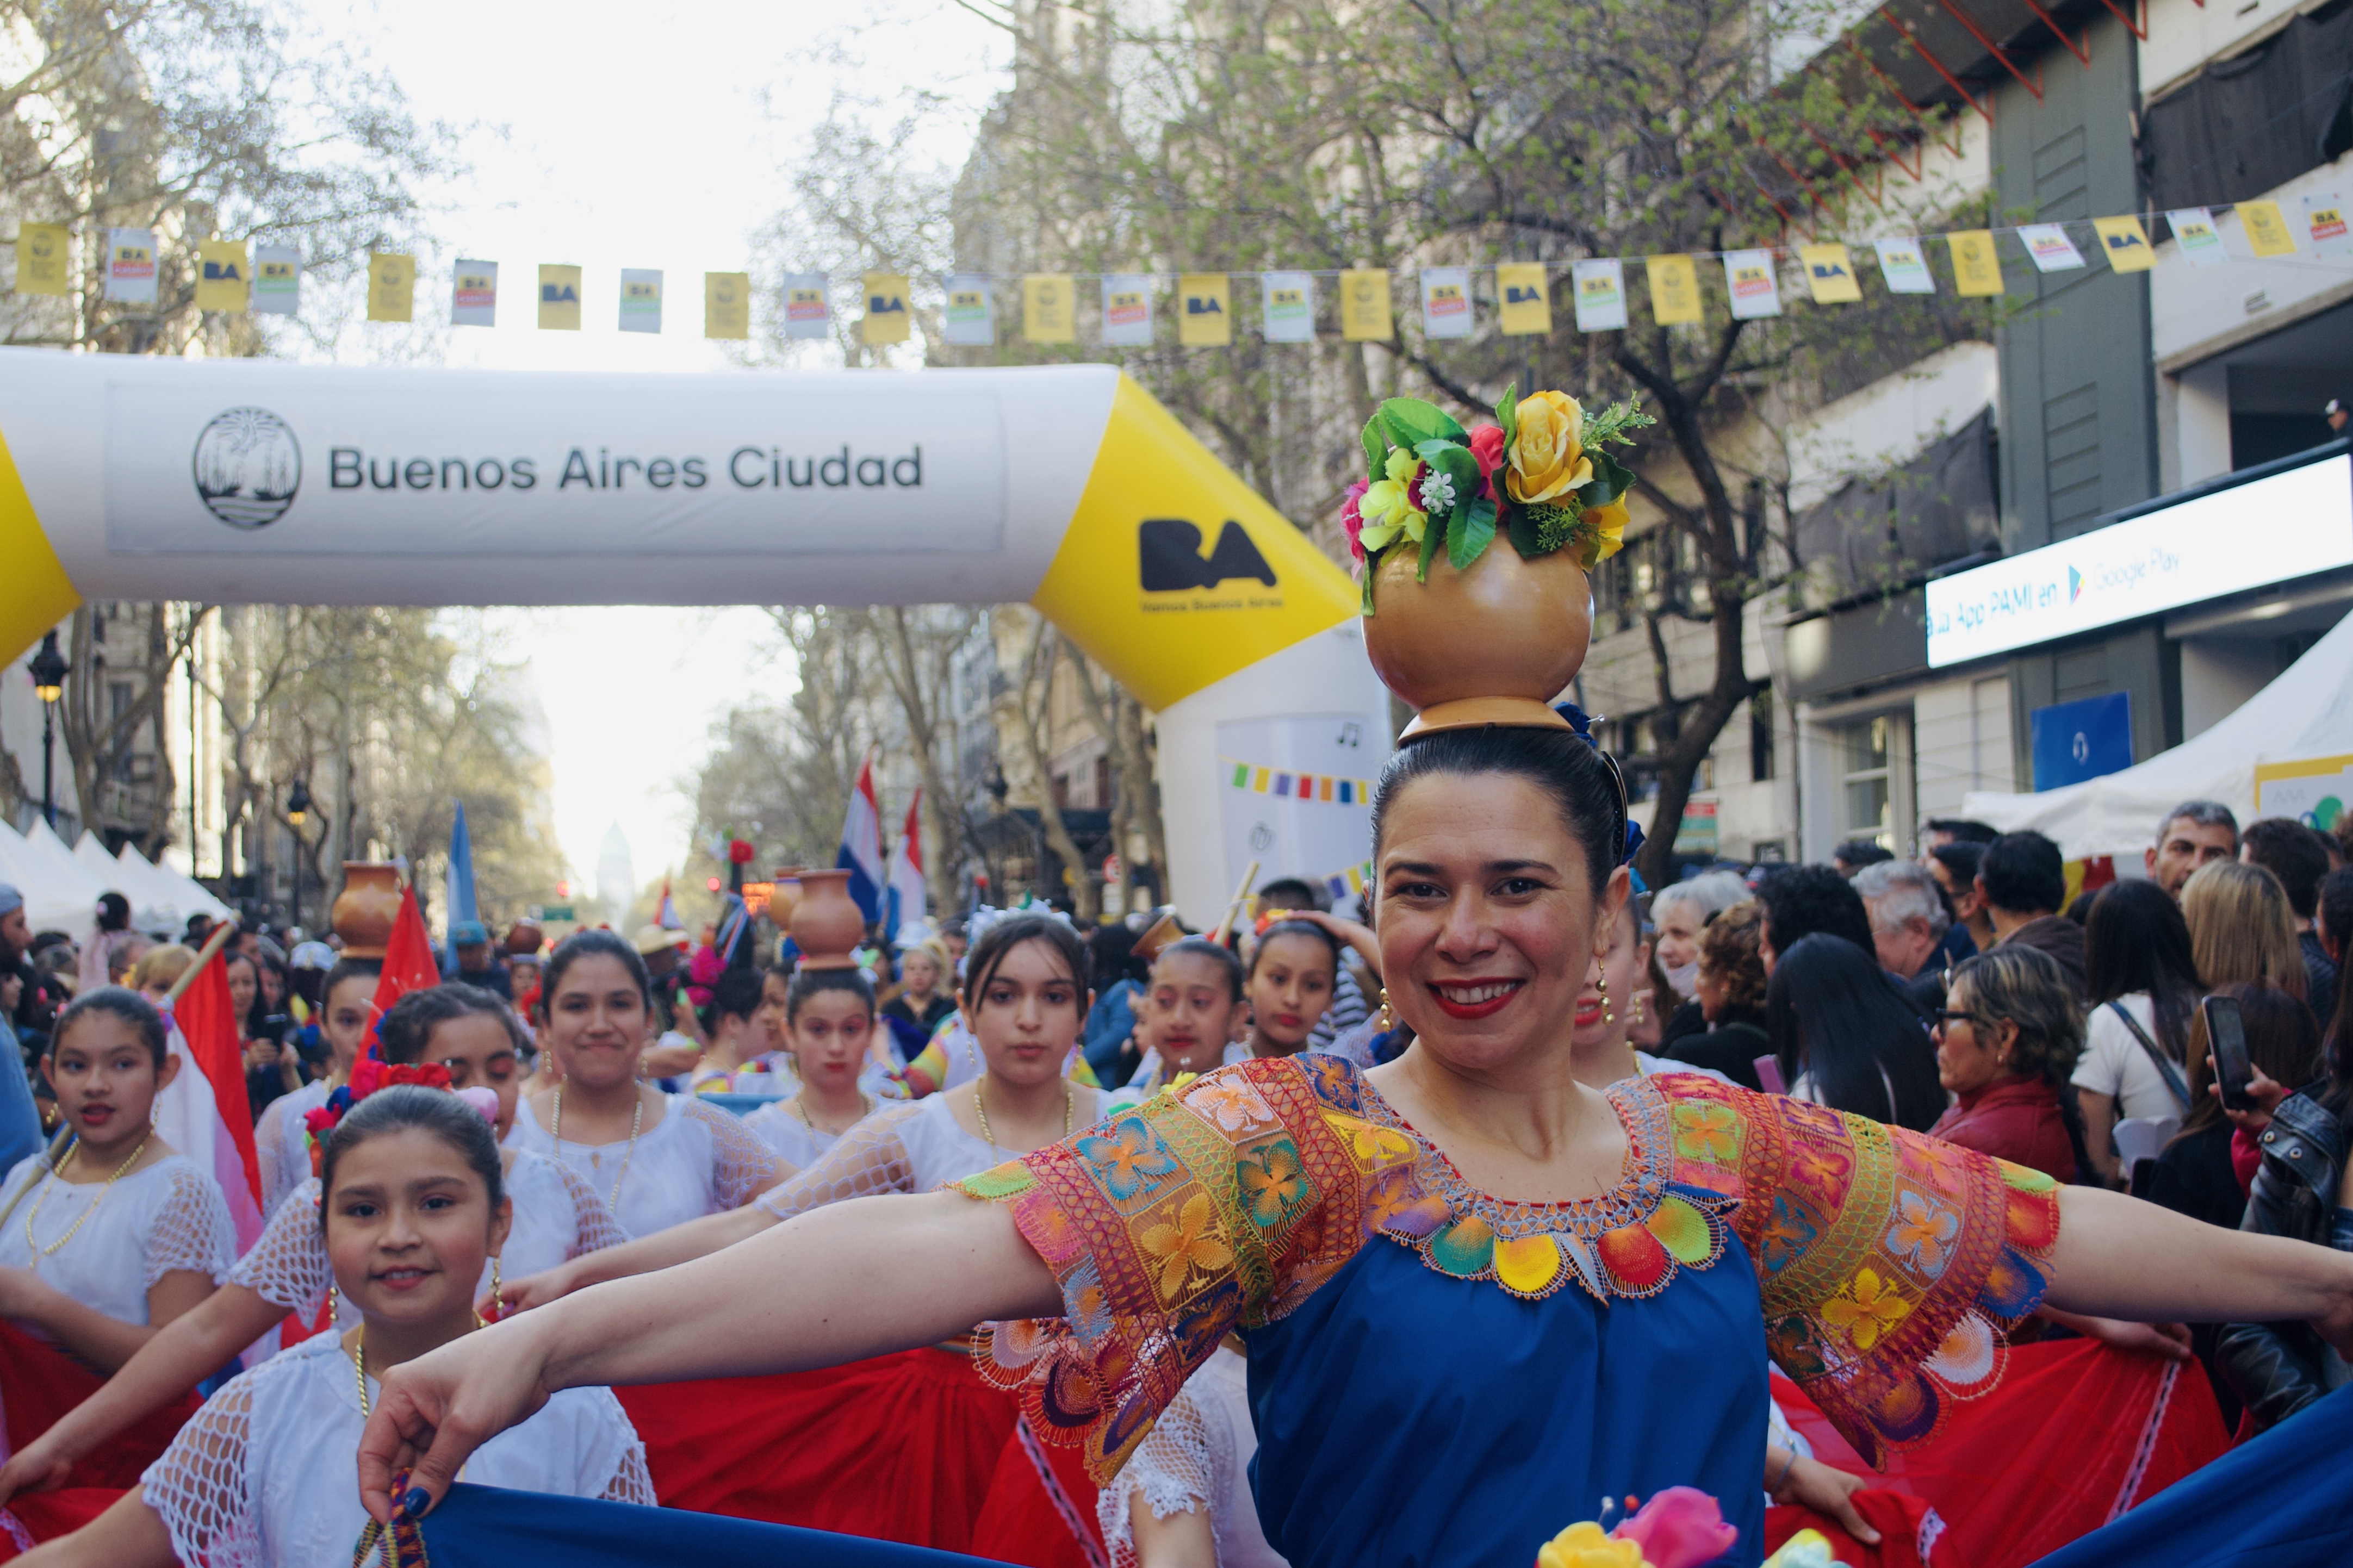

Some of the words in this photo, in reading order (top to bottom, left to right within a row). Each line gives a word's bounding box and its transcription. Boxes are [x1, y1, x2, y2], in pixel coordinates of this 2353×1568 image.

[2315, 212, 2336, 223] BA
[2107, 234, 2144, 249] BA
[203, 262, 240, 281] BA
[1813, 264, 1848, 277] BA
[1506, 287, 1541, 304] BA
[1187, 298, 1222, 315] BA
[330, 447, 537, 489] Buenos
[558, 448, 707, 489] Aires
[729, 443, 921, 488] Ciudad
[1139, 519, 1277, 592] BA
[1957, 601, 1985, 634] App
[1990, 582, 2033, 619] PAMI
[2038, 582, 2057, 607] en
[2094, 558, 2146, 591] Google
[2151, 547, 2180, 577] Play
[1193, 599, 1243, 611] Buenos
[1247, 596, 1283, 608] Aires
